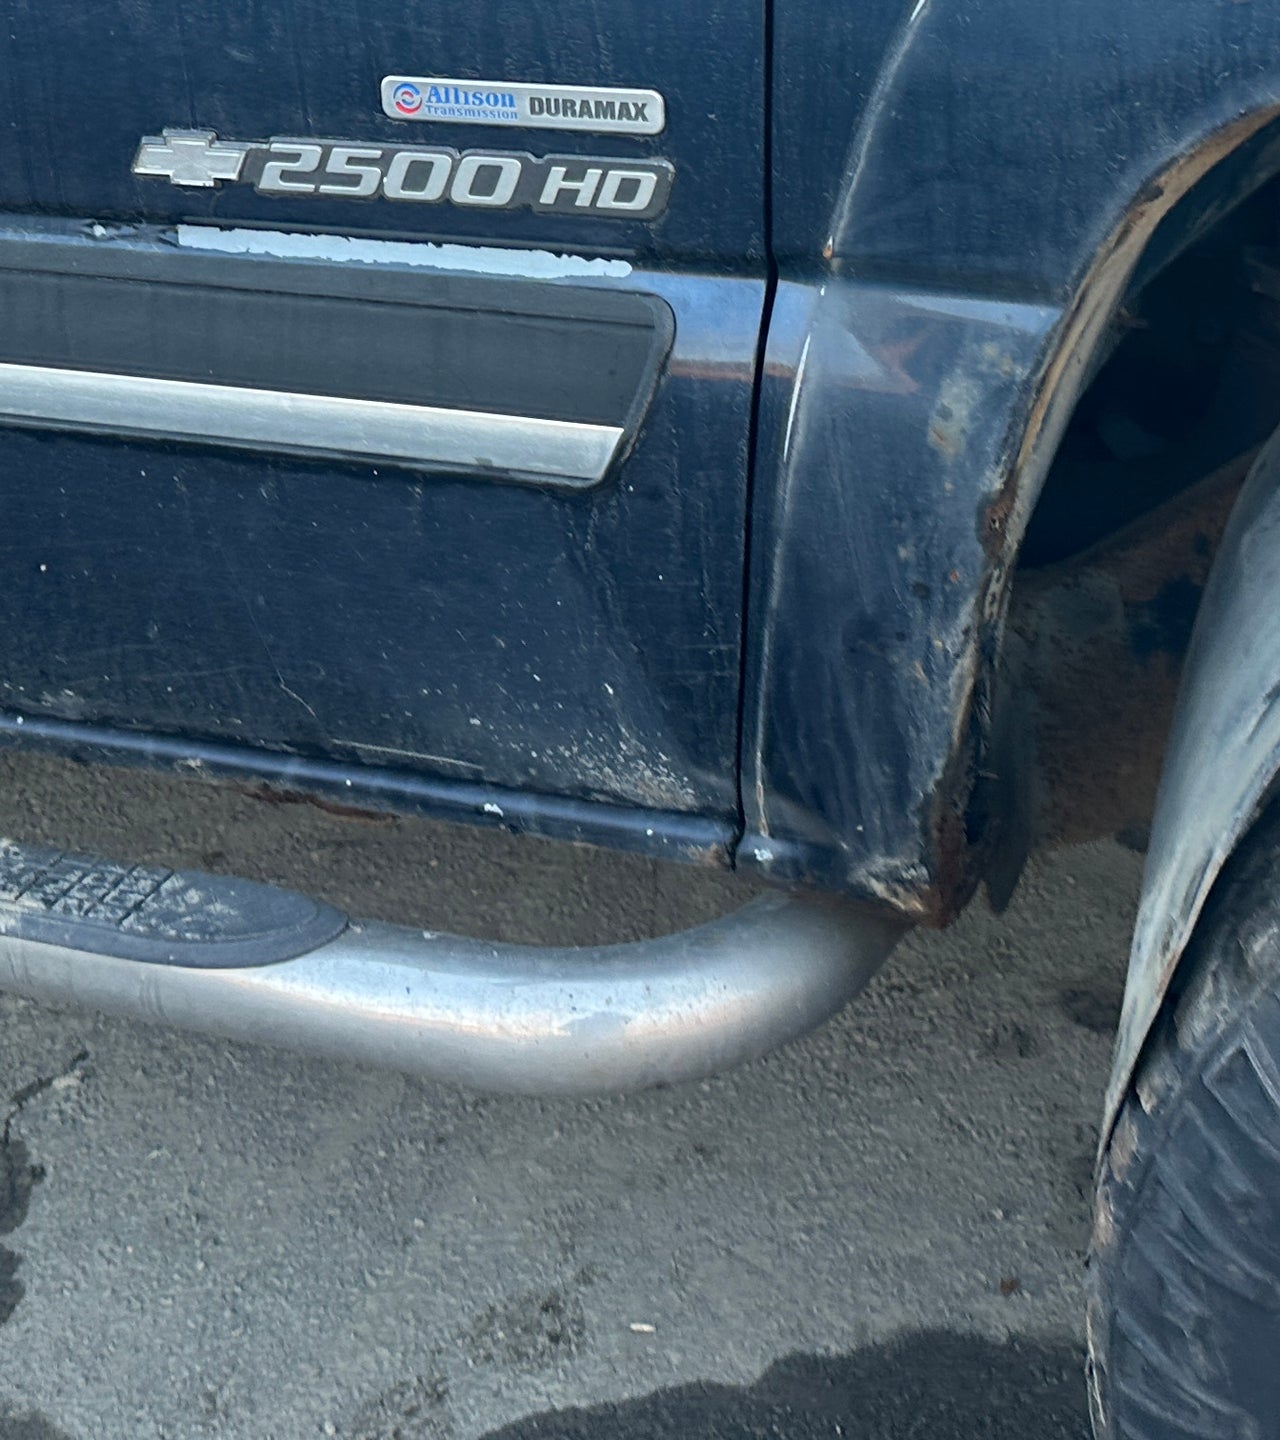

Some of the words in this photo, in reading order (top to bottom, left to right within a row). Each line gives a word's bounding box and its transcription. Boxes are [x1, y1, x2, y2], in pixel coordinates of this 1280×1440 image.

[425, 85, 516, 108] Allison
[425, 105, 519, 120] Transmission
[529, 96, 650, 122] DURAMAX
[257, 142, 522, 207] 2500
[538, 166, 657, 212] HD
